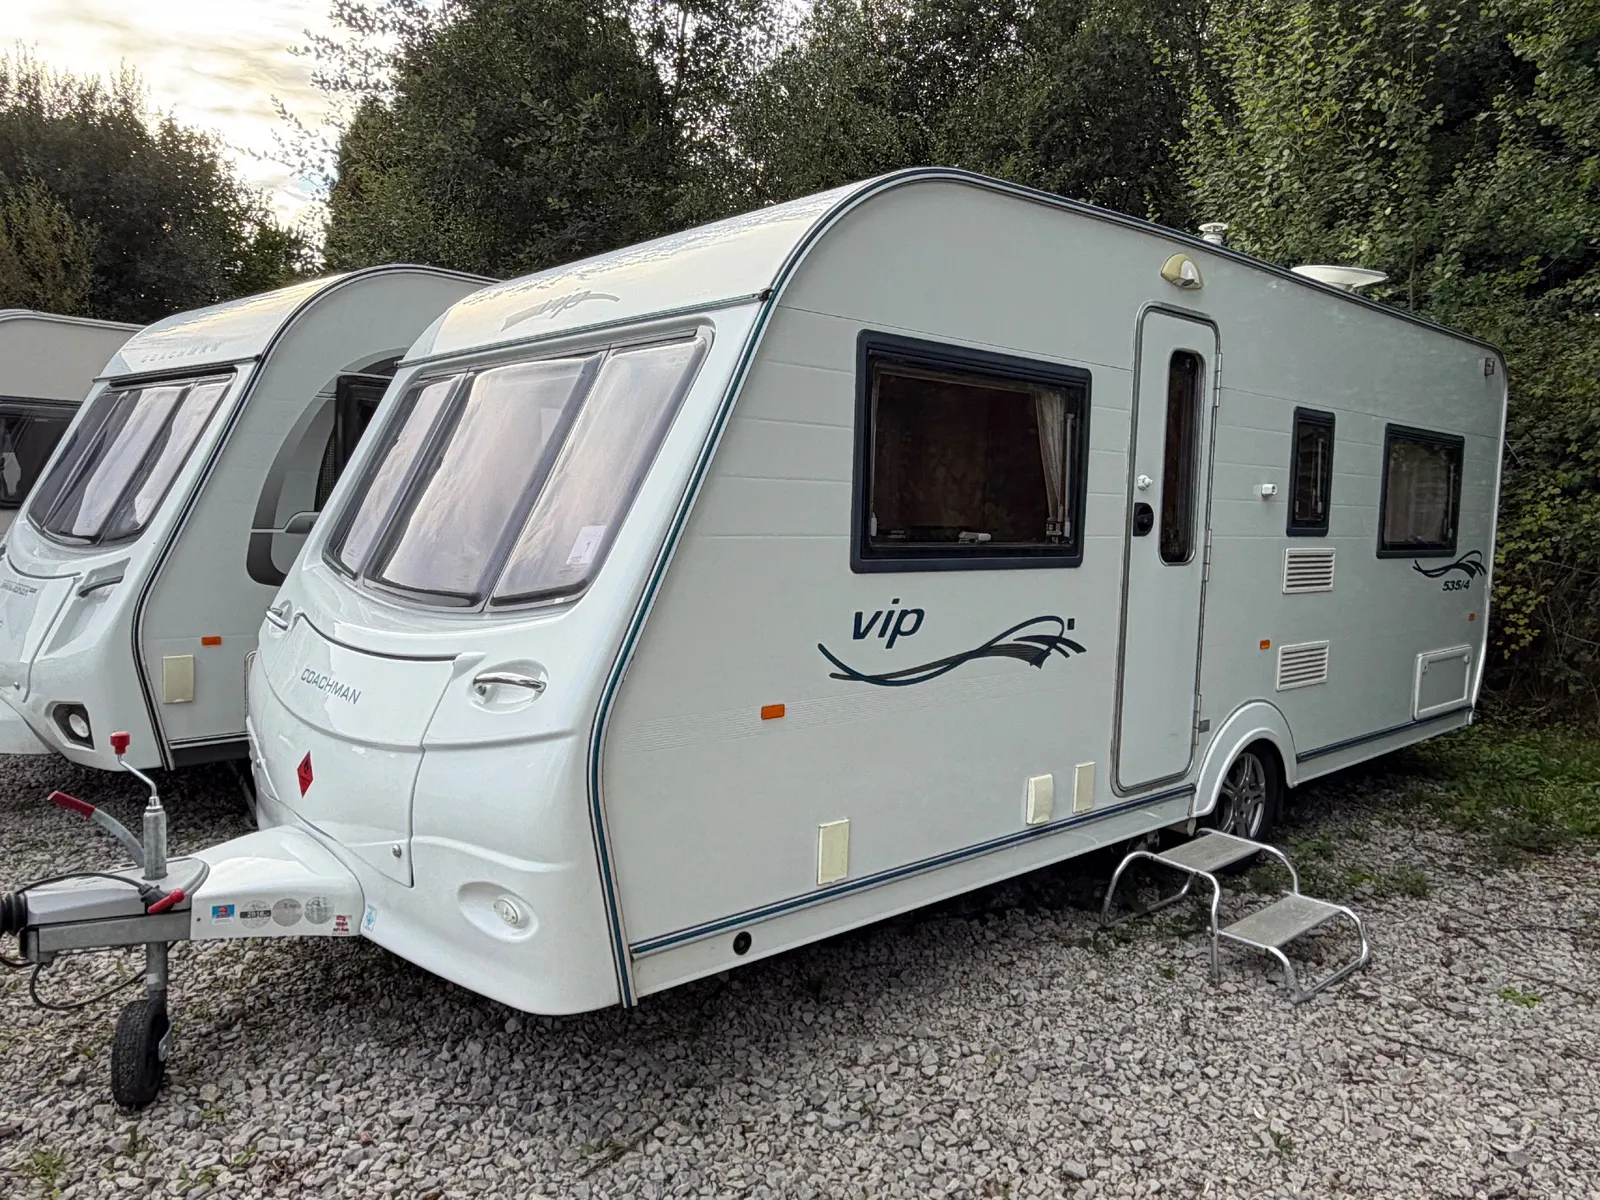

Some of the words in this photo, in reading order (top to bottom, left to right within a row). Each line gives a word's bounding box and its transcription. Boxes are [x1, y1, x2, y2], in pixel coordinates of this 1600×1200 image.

[1442, 580, 1471, 591] 535/4
[852, 598, 926, 649] vip
[301, 668, 361, 705] COACHMAN
